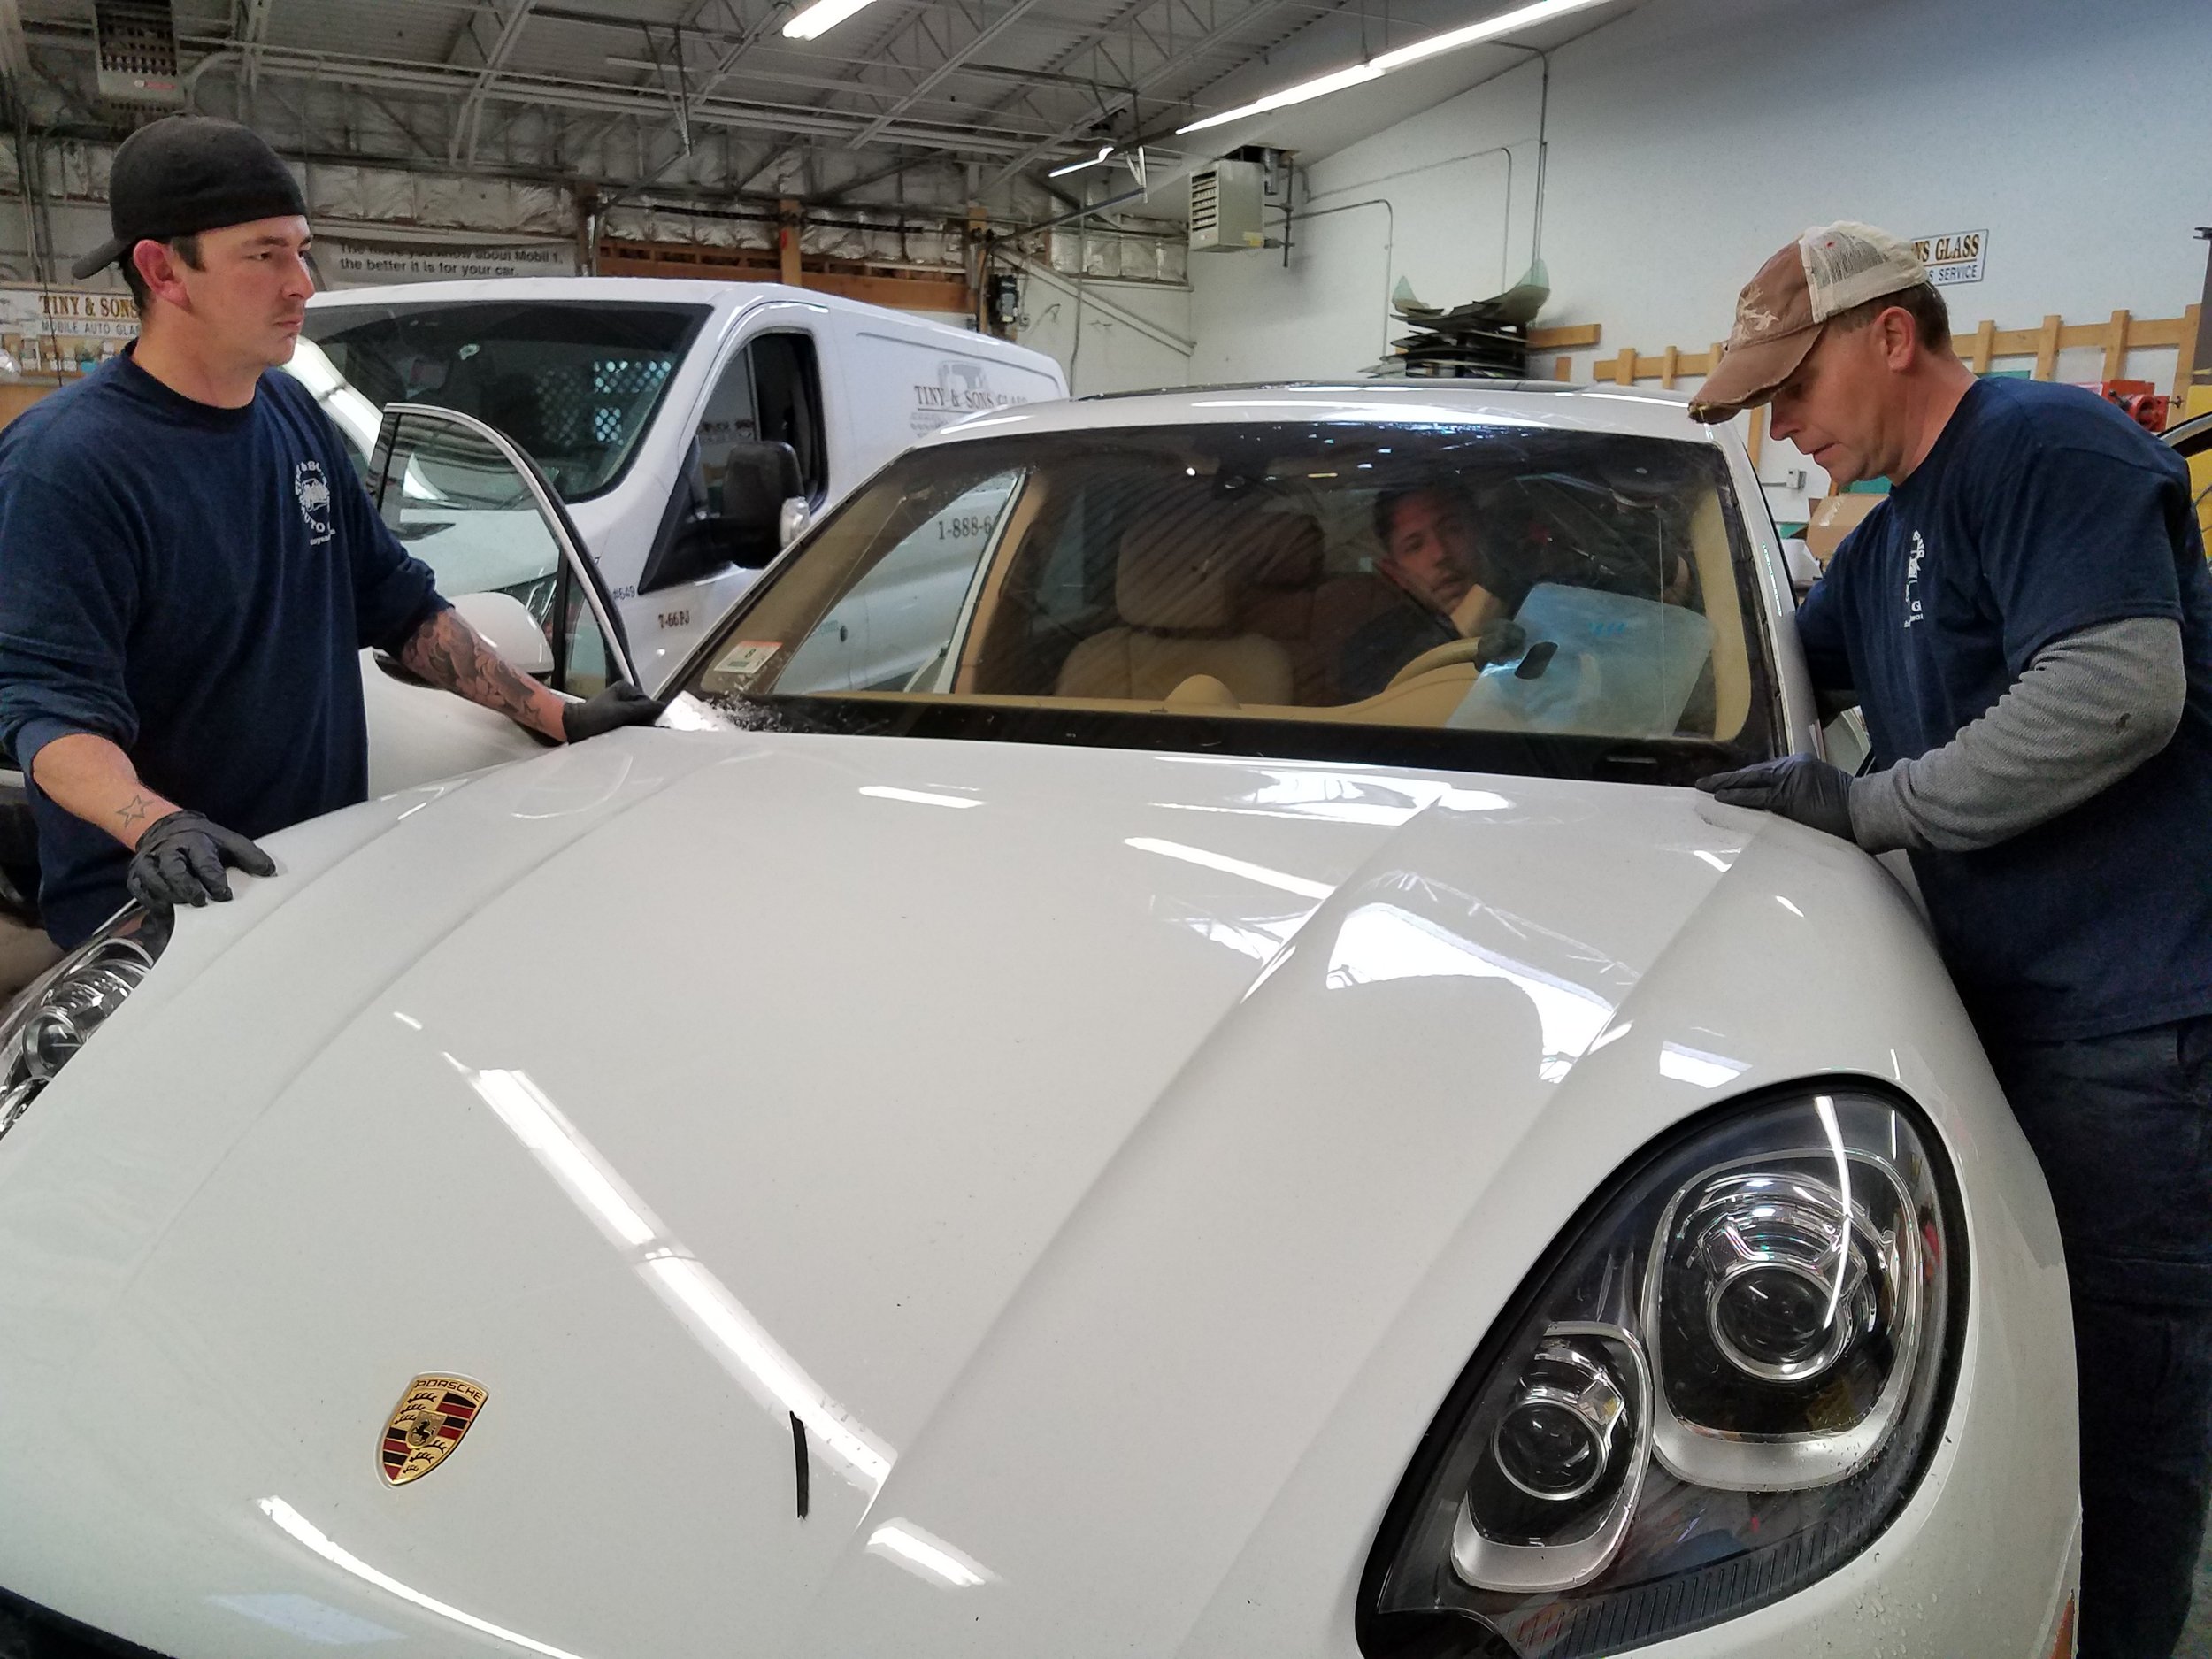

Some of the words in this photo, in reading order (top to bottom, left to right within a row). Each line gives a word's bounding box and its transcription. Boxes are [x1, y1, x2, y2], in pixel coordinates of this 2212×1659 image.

[476, 249, 511, 261] about
[516, 250, 549, 263] Mobil
[1911, 240, 1931, 262] NS
[1936, 234, 1979, 260] GLASS
[340, 257, 362, 270] the
[366, 258, 406, 272] better
[411, 259, 420, 273] it
[423, 259, 435, 273] is
[439, 260, 458, 274] for
[462, 265, 491, 278] your
[1939, 265, 1978, 281] SERVICE
[38, 295, 80, 315] TINY
[85, 296, 96, 317] &
[41, 320, 80, 334] MOBILE
[84, 321, 111, 335] AUTO
[116, 324, 140, 336] GLA
[914, 385, 945, 406] TINY
[951, 388, 960, 408] &
[964, 390, 995, 409] SONS
[938, 515, 994, 541] 1-888-6
[414, 1379, 483, 1402] PORSCHE
